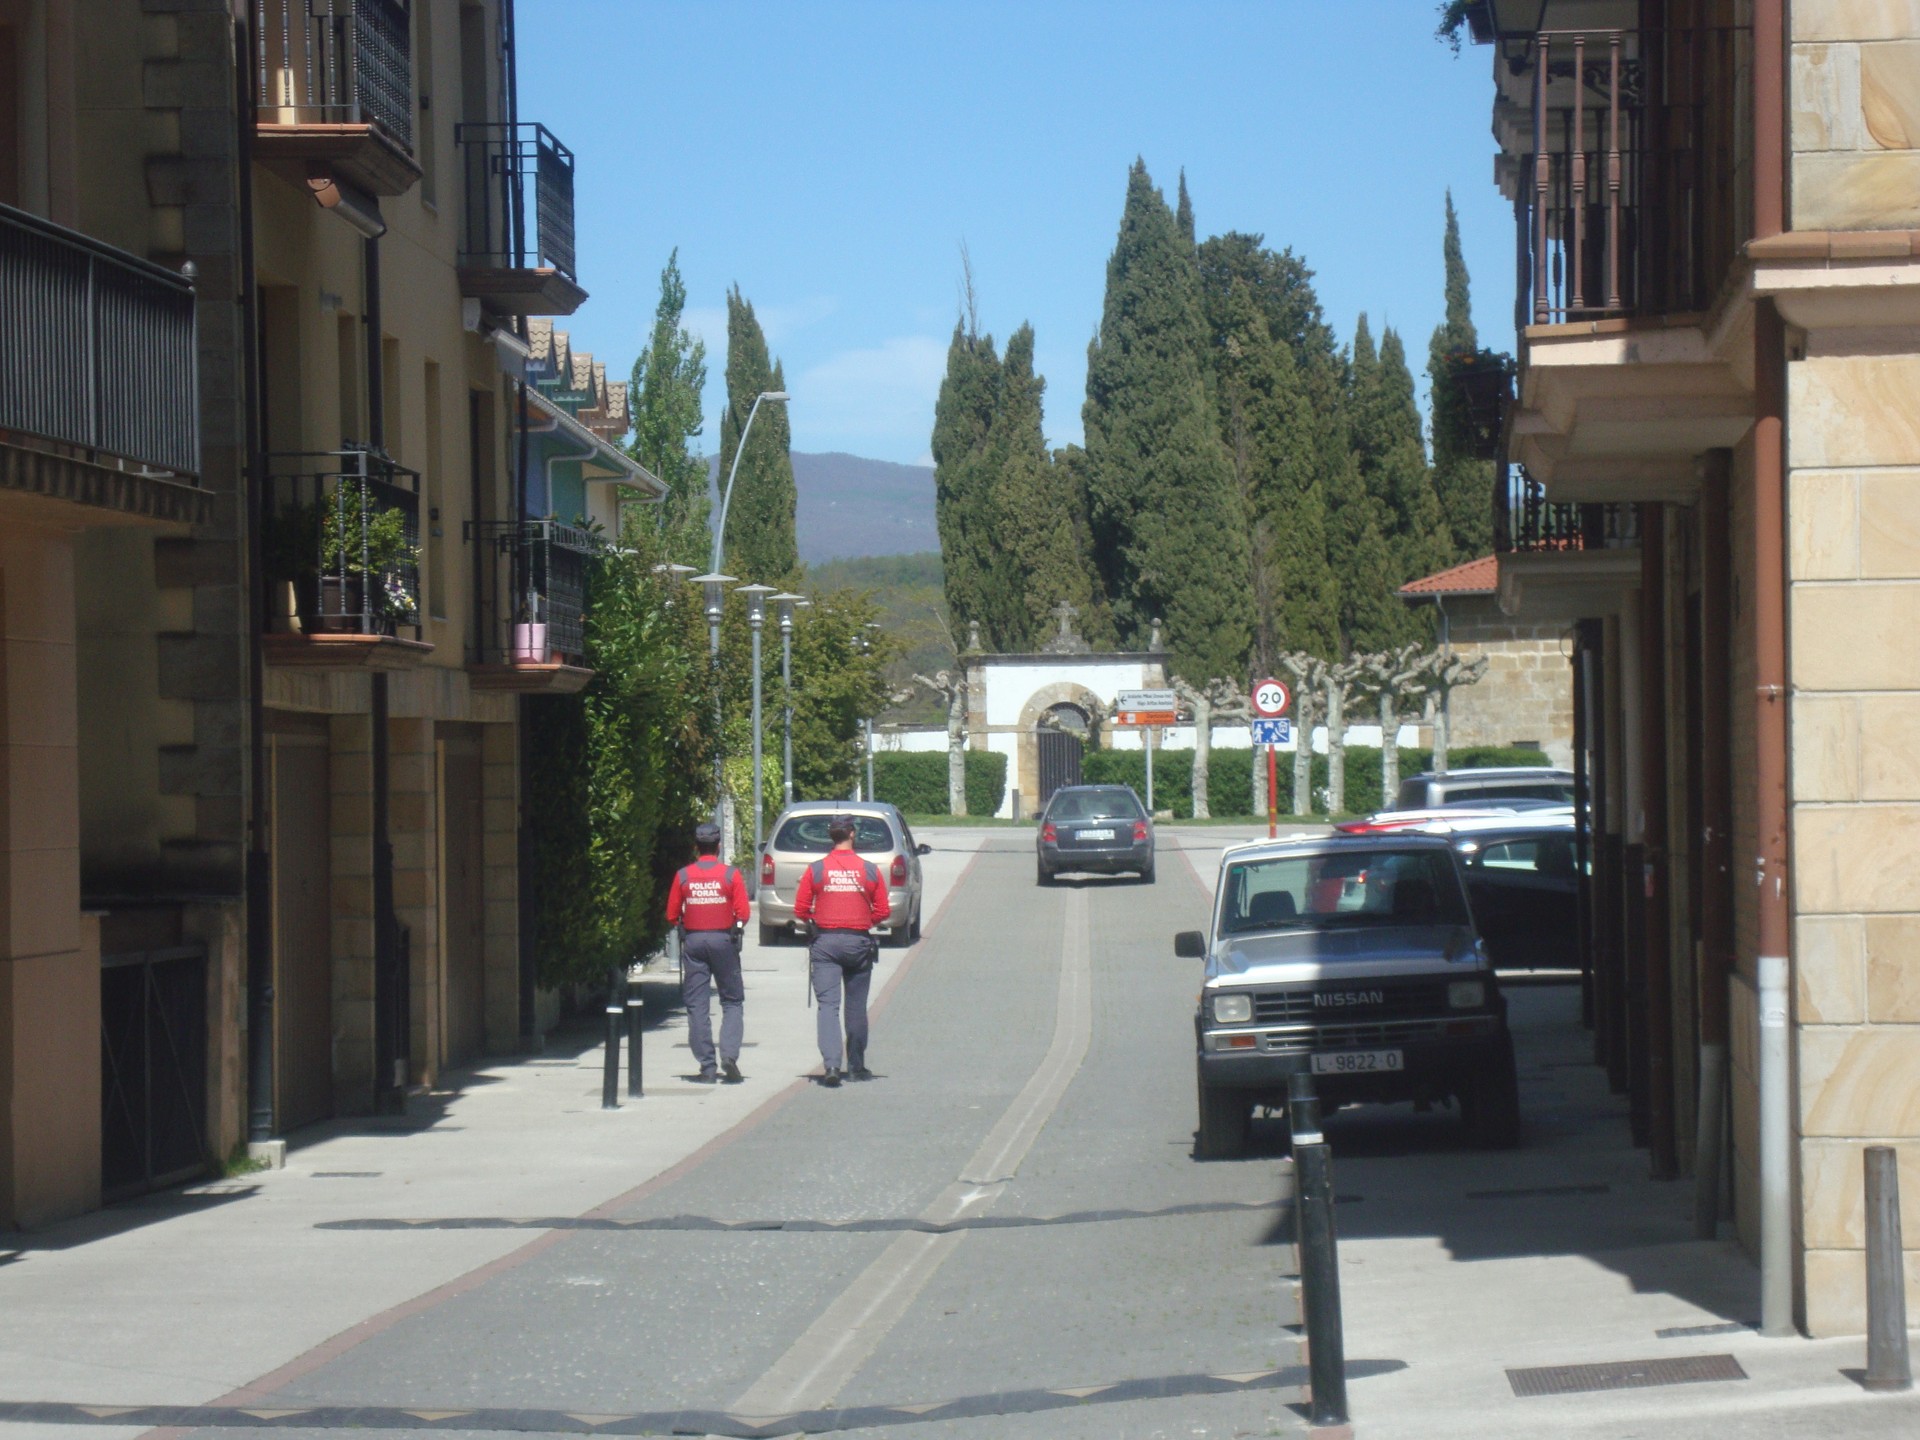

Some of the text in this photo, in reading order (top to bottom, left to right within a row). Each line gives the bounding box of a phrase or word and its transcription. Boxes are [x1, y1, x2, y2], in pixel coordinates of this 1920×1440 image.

[1260, 692, 1282, 704] 20
[689, 881, 721, 890] POLICÍA
[830, 877, 859, 885] FORAL
[1313, 991, 1384, 1007] NISSAN
